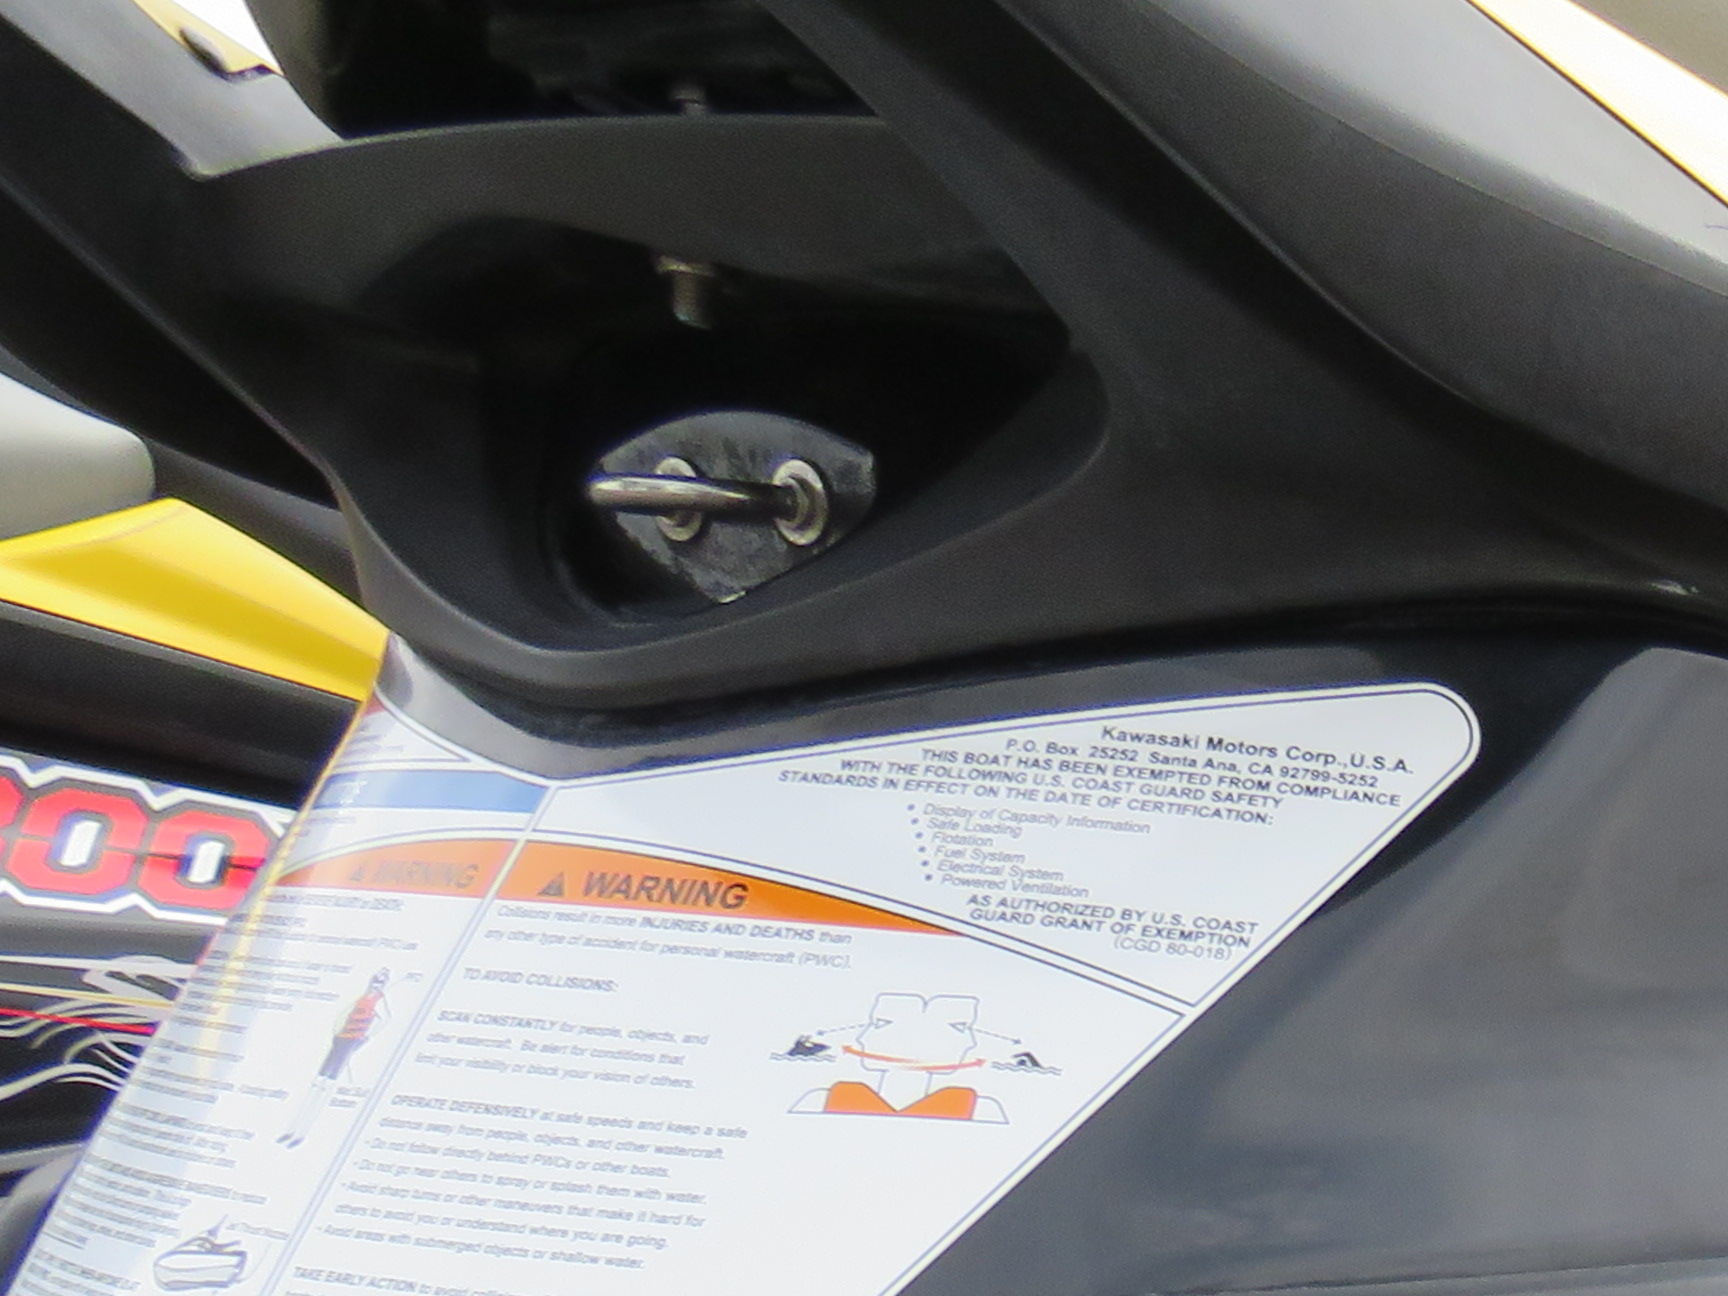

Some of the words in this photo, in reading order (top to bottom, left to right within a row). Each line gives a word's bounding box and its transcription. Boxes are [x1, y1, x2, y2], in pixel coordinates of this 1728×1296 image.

[1101, 725, 1199, 749] Kawasaki
[1206, 736, 1277, 758] Motors
[1006, 738, 1039, 752] P.O.
[1045, 741, 1077, 756] Box
[1088, 745, 1138, 762] 25252
[1148, 750, 1197, 768] Santa
[1202, 757, 1241, 774] Ana,
[1247, 761, 1273, 776] CA
[1279, 765, 1378, 787] 92799-5252
[840, 759, 882, 772] WITH
[887, 761, 920, 776] THE
[923, 764, 1027, 784] FOLLOWING
[1032, 774, 1065, 787] U.S.
[1071, 777, 1134, 793] COAST
[1139, 783, 1206, 800] GUARD
[1210, 790, 1283, 808] SAFETY
[922, 748, 958, 763] THIS
[963, 751, 1012, 766] BOAT
[1016, 756, 1053, 771] HAS
[1058, 760, 1107, 775] BEEN
[1112, 765, 1212, 786] EXEMPTED
[1217, 775, 1271, 792] FROM
[1276, 781, 1400, 806] COMPLIANCE
[777, 769, 879, 788] STANDARDS
[882, 777, 900, 789] IN
[903, 779, 970, 794] EFFECT
[973, 785, 999, 797] ON
[1006, 788, 1039, 801] THE
[1043, 791, 1092, 806] DATE
[1097, 796, 1122, 808] OF
[1126, 798, 1273, 825] CERTIFICATION:
[922, 802, 977, 823] Display
[981, 809, 998, 820] of
[997, 808, 1063, 828] Capacity
[1065, 814, 1151, 834] Information
[926, 816, 960, 831] Safe
[962, 819, 1022, 839] Loading
[930, 830, 993, 847] Flotation
[934, 844, 967, 859] Fuel
[969, 847, 1025, 865] System
[936, 860, 1004, 877] Electrical
[1005, 864, 1063, 882] System
[582, 871, 749, 910] WARNING
[940, 873, 1007, 890] Powered
[1011, 879, 1089, 898] Ventilation
[966, 894, 992, 907] AS
[995, 896, 1115, 918] AUTHORIZED
[1120, 908, 1146, 922] BY
[1151, 912, 1189, 928] U.S.
[1192, 916, 1258, 933] COAST
[969, 907, 1035, 925] GUARD
[1039, 914, 1106, 931] GRANT
[1109, 921, 1136, 934] OF
[1140, 924, 1250, 947] EXEMPTION
[639, 916, 710, 933] INJURIES
[710, 922, 747, 936] AND
[748, 924, 815, 941] DEATHS
[818, 931, 852, 944] than
[1113, 935, 1161, 953] (CGD
[658, 943, 722, 957] personal
[723, 949, 795, 964] watercraft
[797, 951, 851, 969] (PWC).
[715, 1126, 748, 1138] safe
[365, 1276, 418, 1292] ACTION
